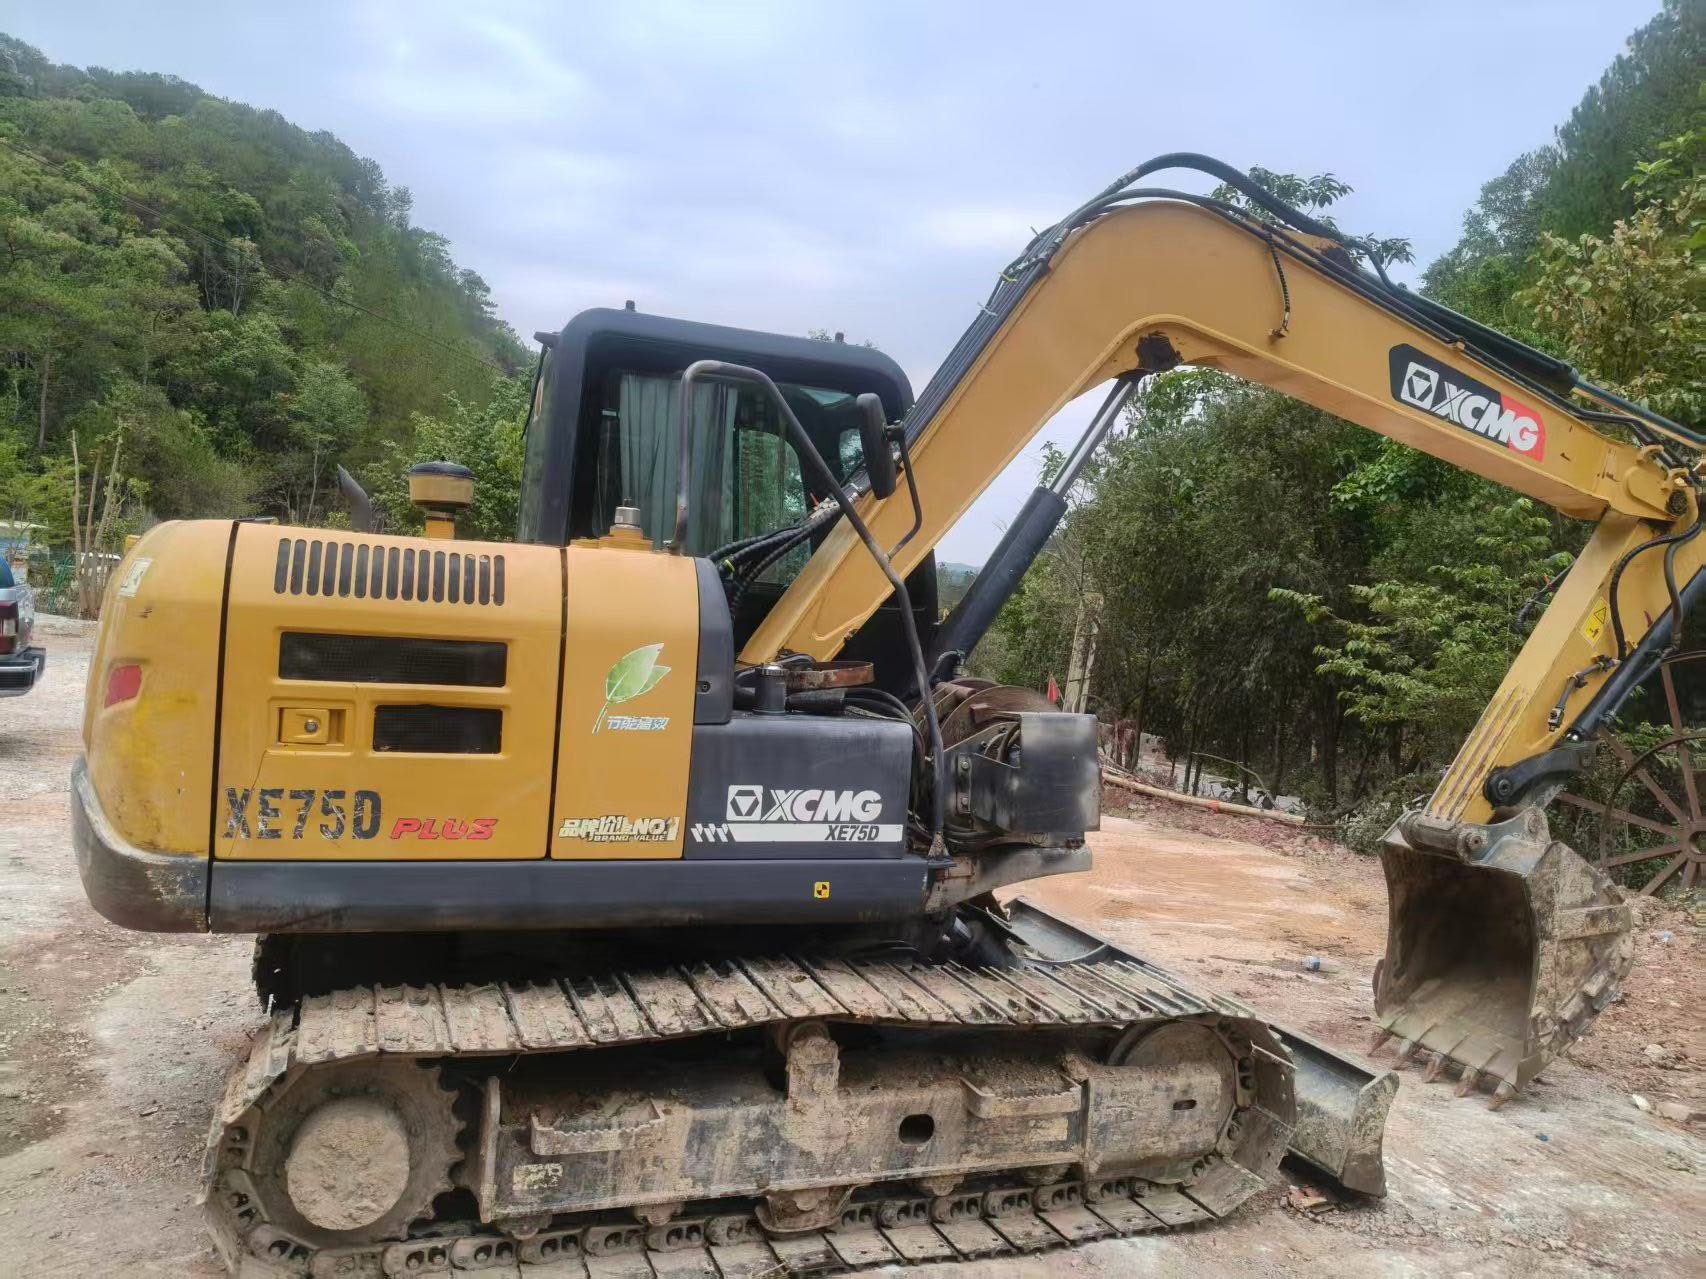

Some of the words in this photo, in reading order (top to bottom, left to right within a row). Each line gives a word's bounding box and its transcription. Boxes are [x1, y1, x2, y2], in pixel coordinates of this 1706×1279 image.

[1430, 381, 1539, 451] XCMG
[222, 787, 382, 840] XE75D
[390, 817, 499, 840] PLUS
[761, 789, 883, 822] XCMG
[595, 834, 630, 842] BRAND
[635, 834, 667, 842] VALUE
[825, 824, 880, 841] XE75D
